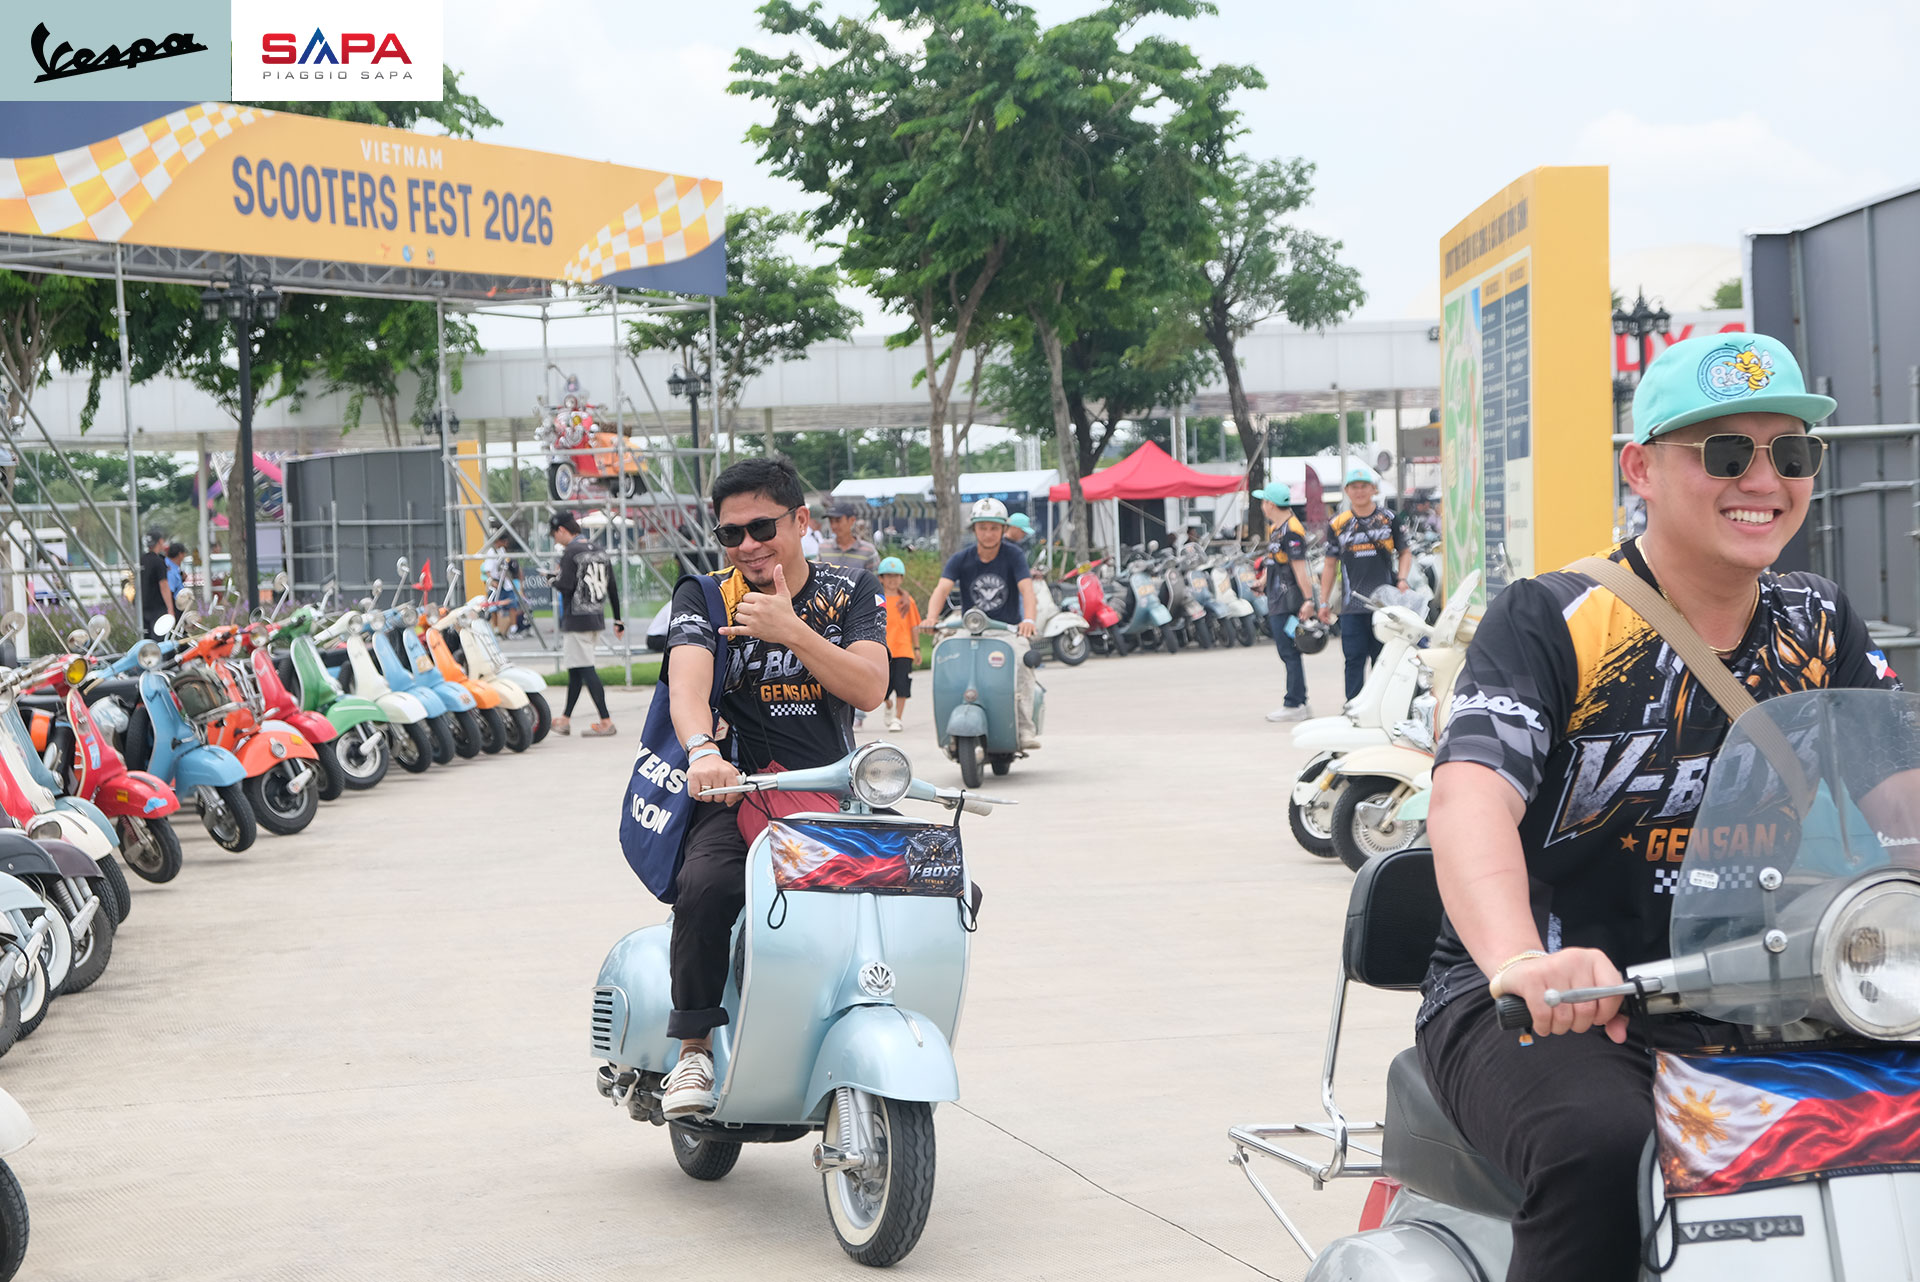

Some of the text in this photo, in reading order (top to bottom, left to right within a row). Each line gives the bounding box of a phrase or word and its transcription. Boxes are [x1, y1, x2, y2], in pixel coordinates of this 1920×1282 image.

[360, 138, 444, 170] VIETNAM
[232, 155, 554, 246] SCOOTERS FEST 2026
[760, 683, 823, 702] GENSAN
[1645, 822, 1777, 863] GENSAN
[909, 864, 961, 881] V-BOYS
[1682, 1219, 1800, 1240] vespa
